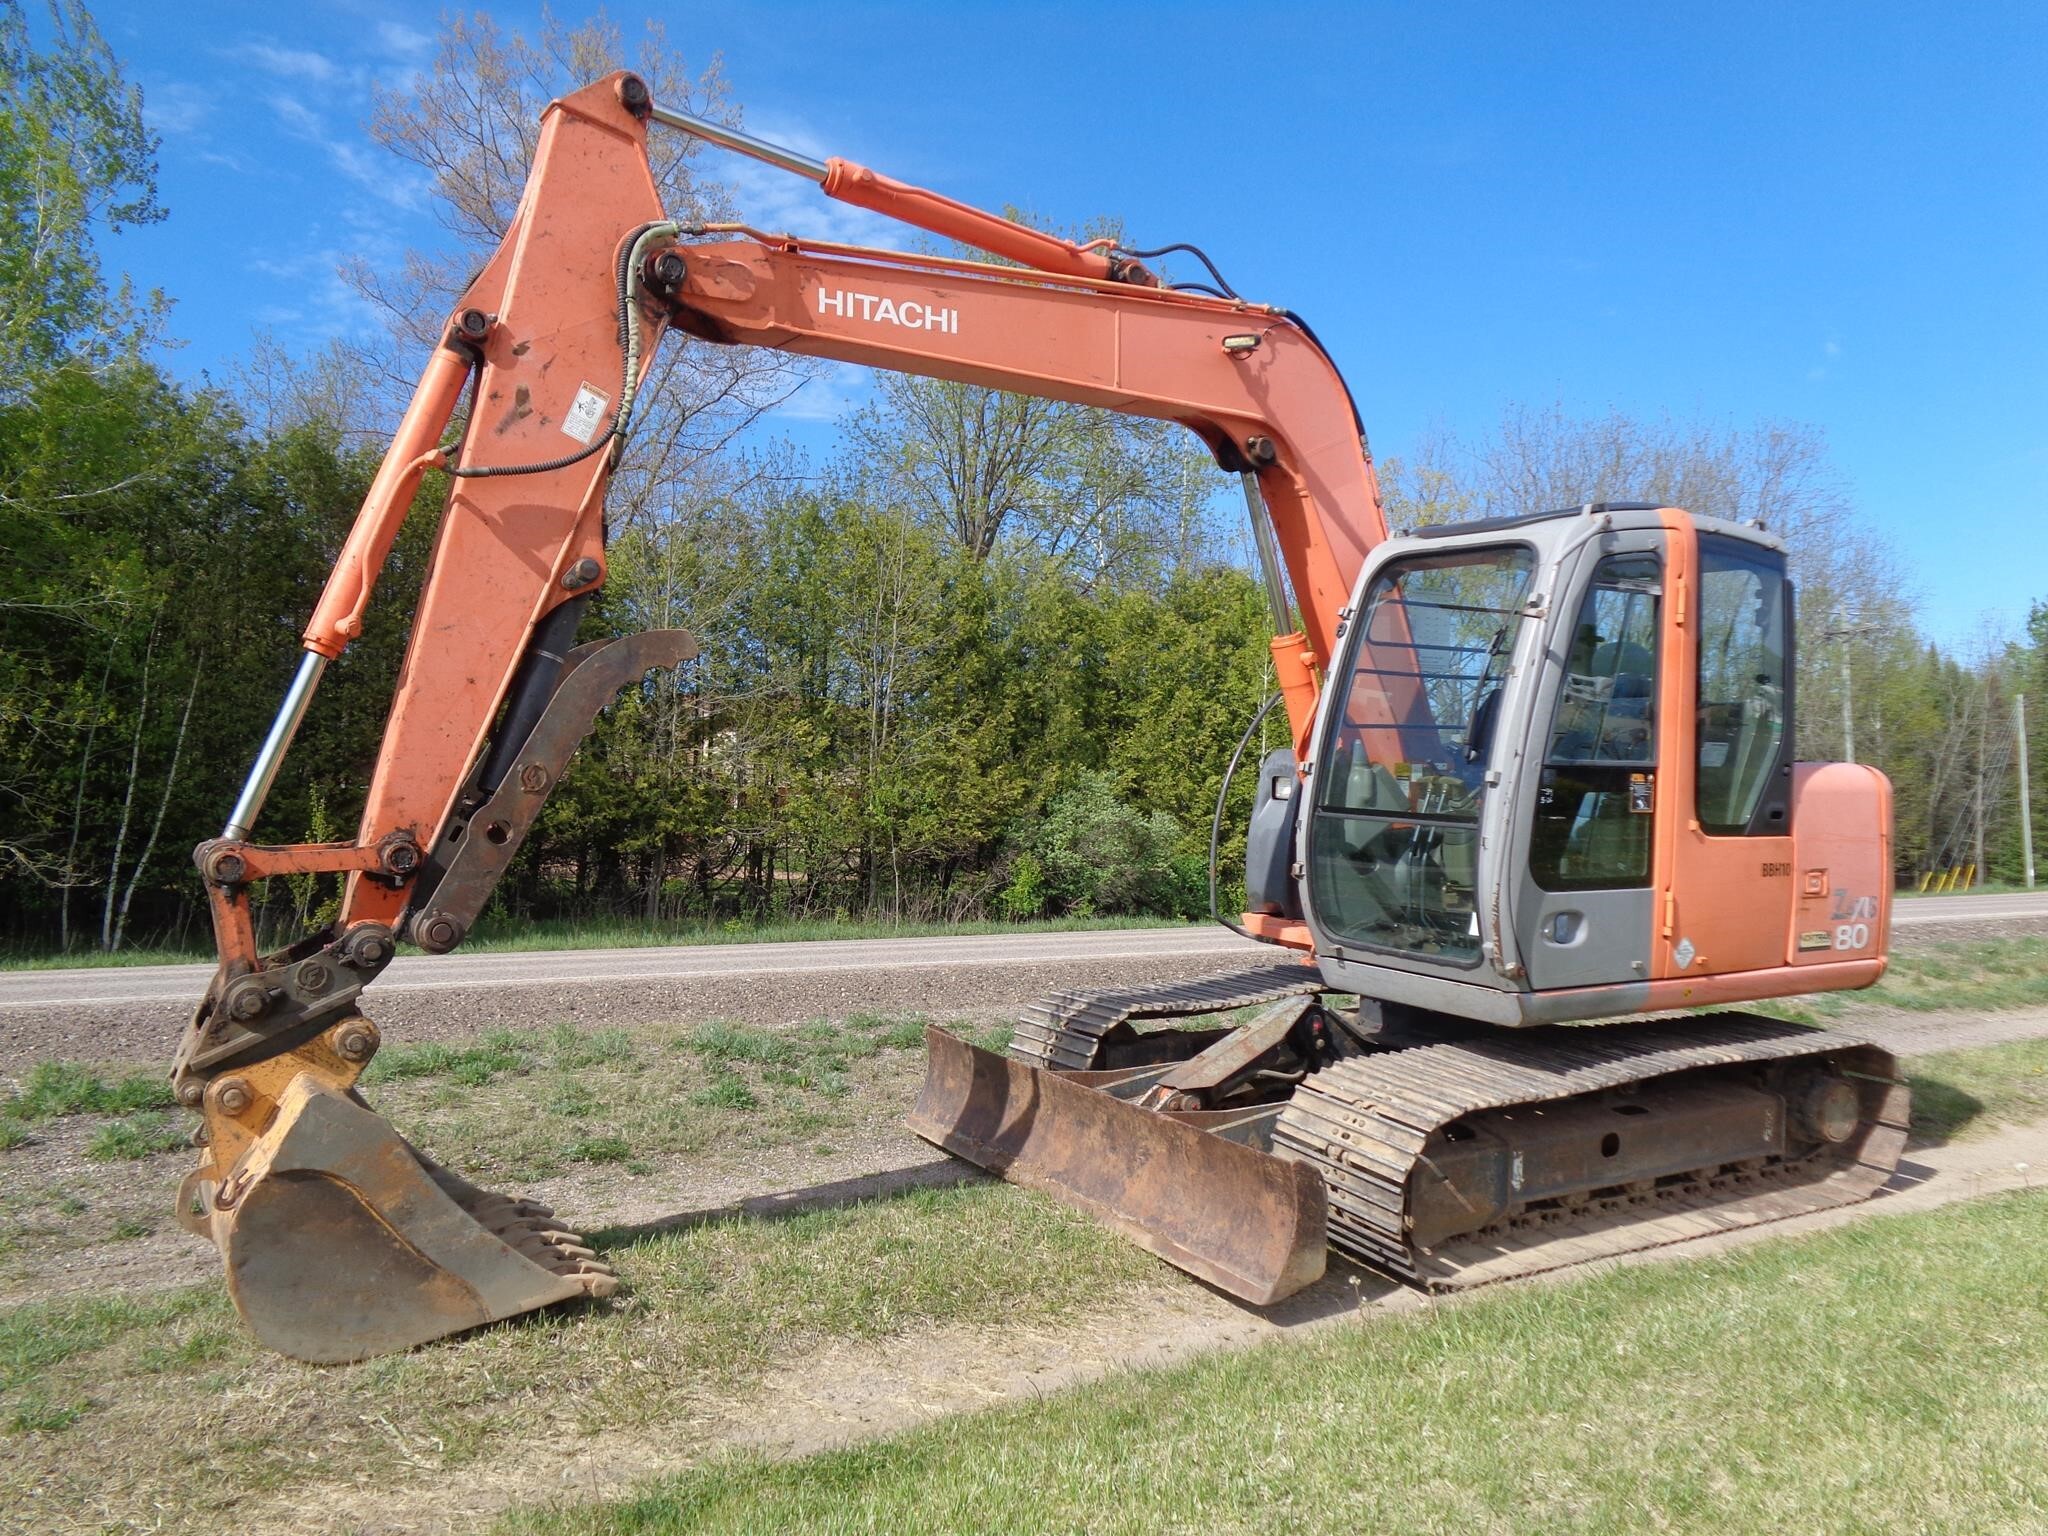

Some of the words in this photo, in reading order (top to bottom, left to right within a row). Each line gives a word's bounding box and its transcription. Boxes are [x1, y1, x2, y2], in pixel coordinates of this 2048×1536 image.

[818, 287, 958, 334] HITACHI
[1762, 863, 1791, 877] BBH10
[1835, 923, 1869, 951] 80
